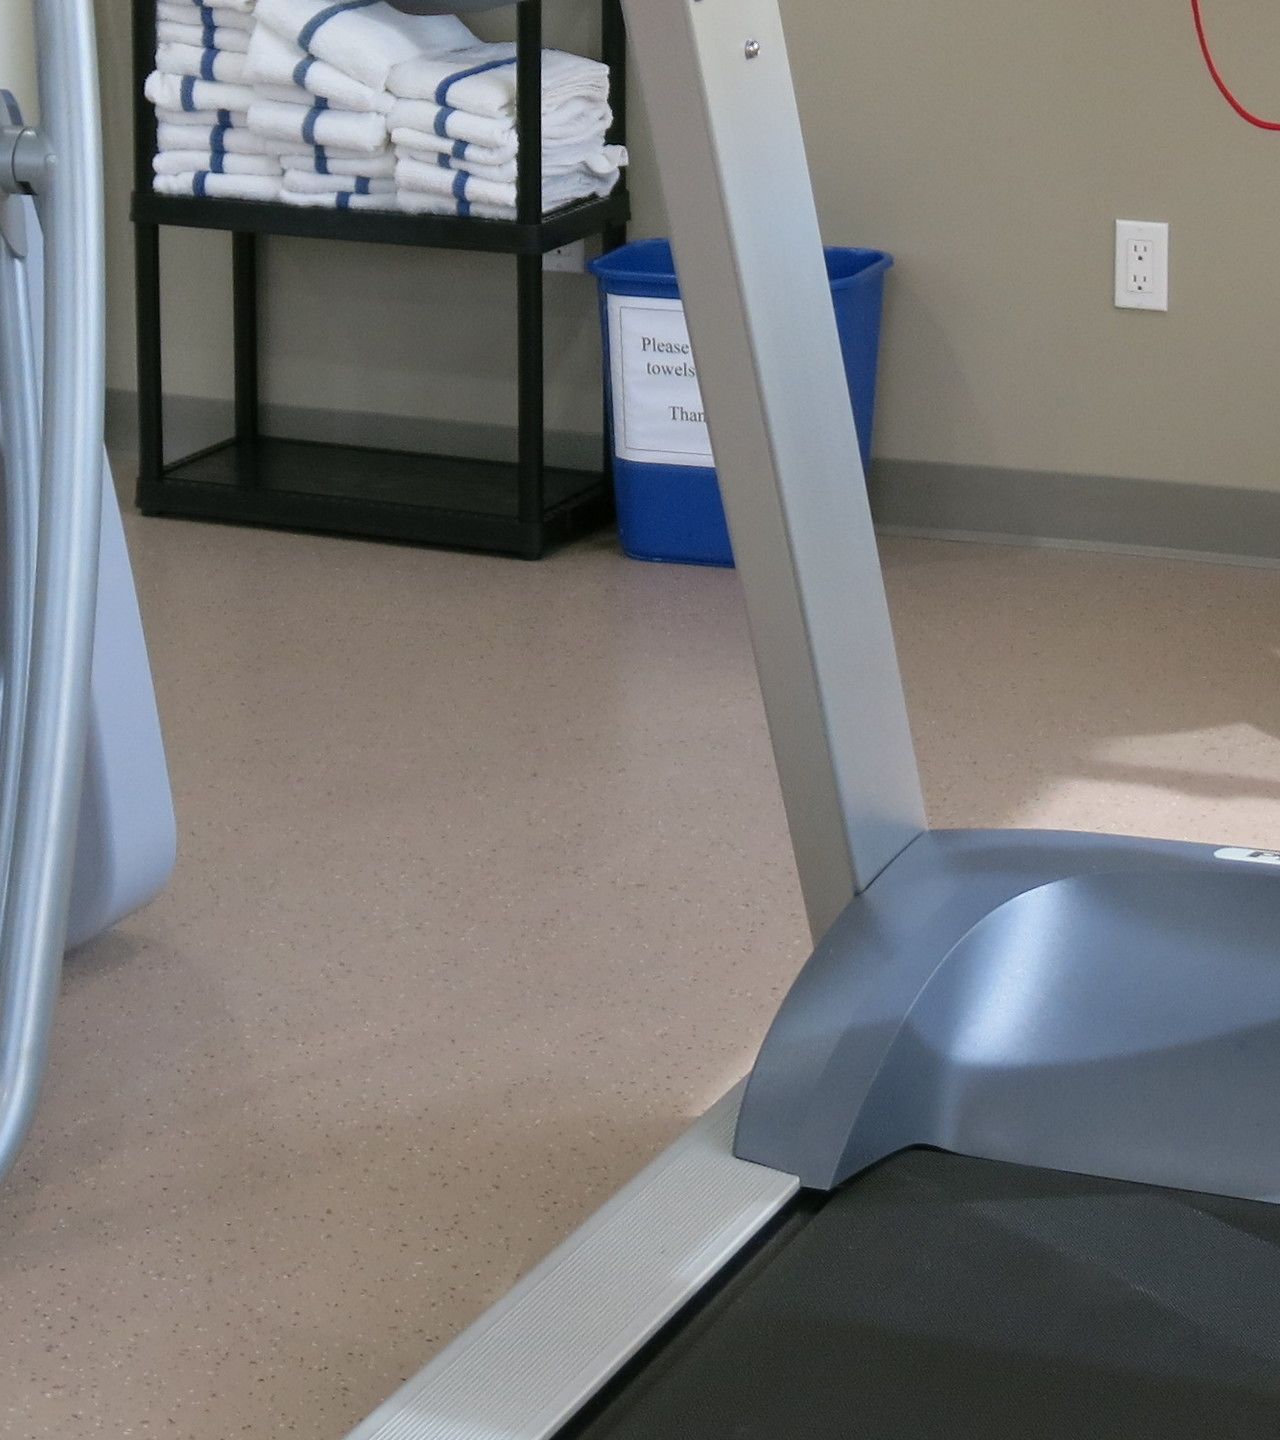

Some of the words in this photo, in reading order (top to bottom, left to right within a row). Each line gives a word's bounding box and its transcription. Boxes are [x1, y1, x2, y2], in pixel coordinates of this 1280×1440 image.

[641, 336, 690, 355] Please
[646, 362, 696, 378] towels
[668, 405, 705, 423] Than
